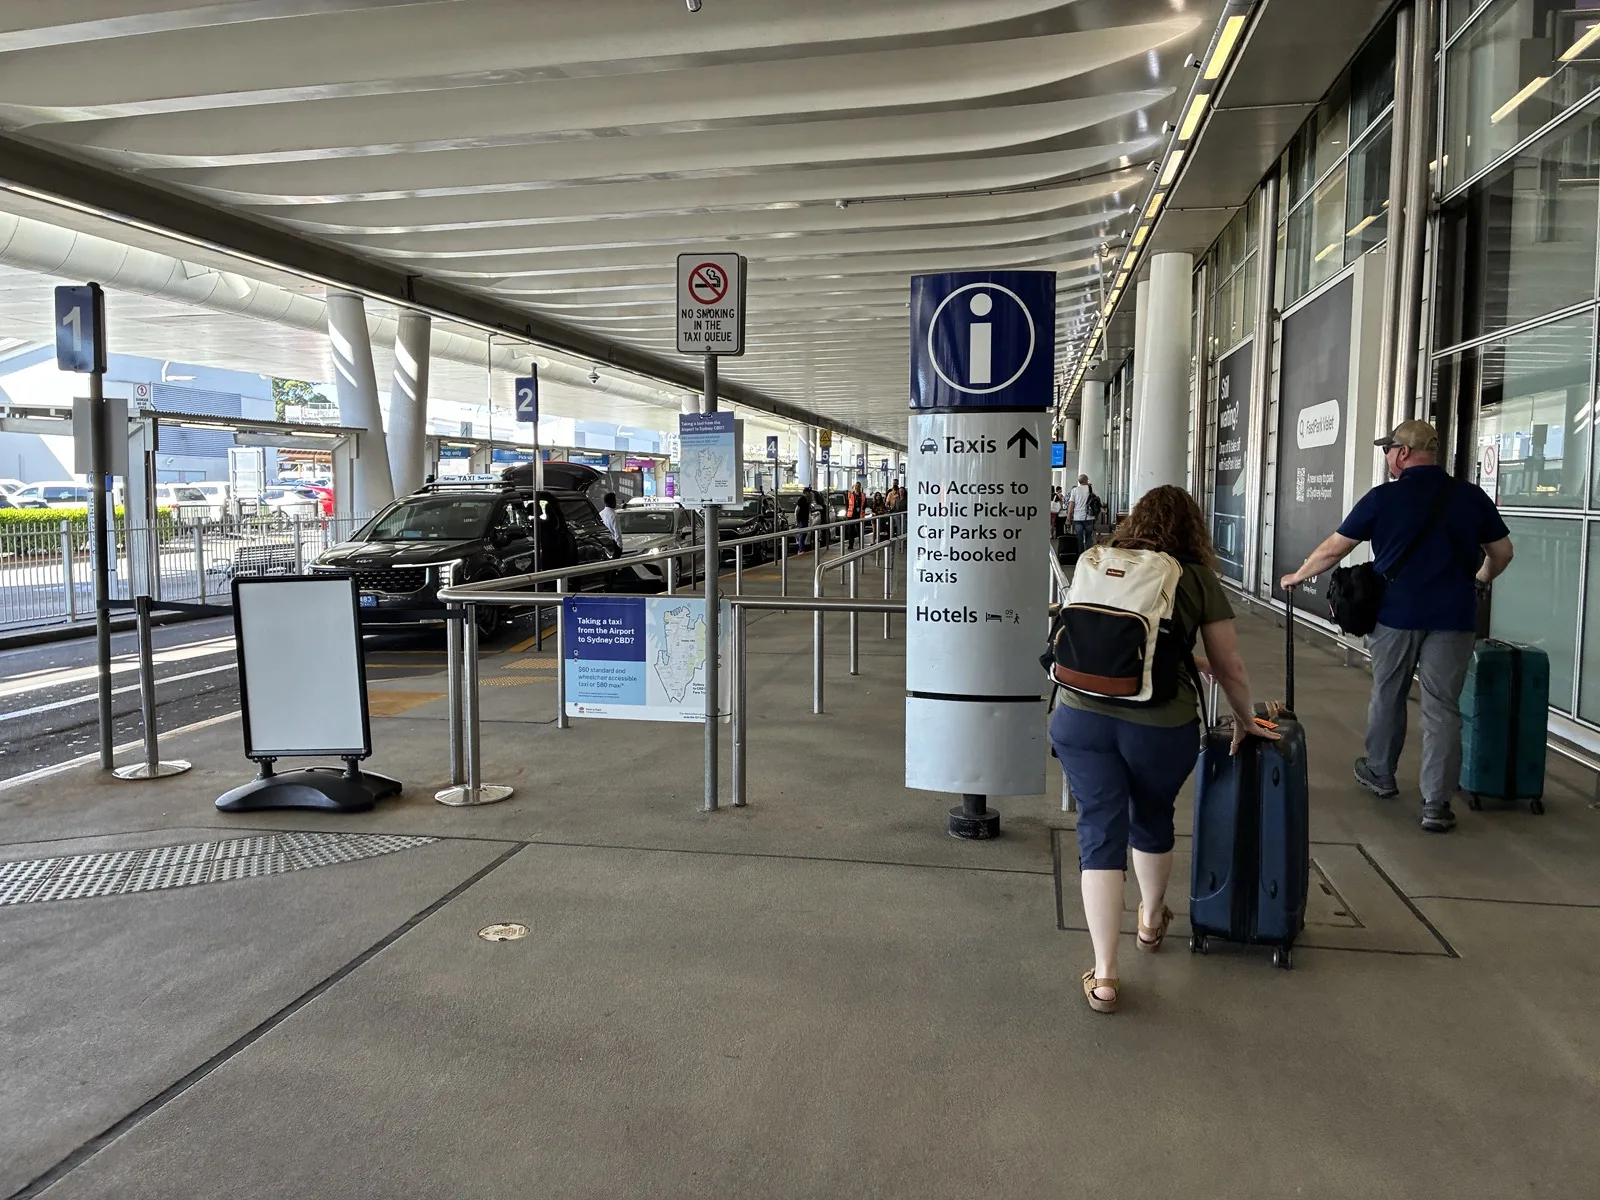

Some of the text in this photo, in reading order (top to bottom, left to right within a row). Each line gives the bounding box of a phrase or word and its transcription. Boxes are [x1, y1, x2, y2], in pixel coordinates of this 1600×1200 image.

[681, 308, 735, 319] NO SMOKING
[62, 306, 83, 352] 1
[693, 320, 721, 330] IN THE
[683, 331, 732, 342] TAXI QUEUE
[518, 388, 533, 412] 2
[767, 440, 776, 454] 4
[942, 434, 997, 454] Taxis
[822, 450, 829, 460] 5
[857, 457, 863, 466] 6
[882, 461, 887, 470] 7
[900, 464, 905, 472] 8
[918, 480, 1029, 495] No Access to
[918, 502, 1038, 520] Public Pick-up
[917, 524, 1022, 539] Car Parks or
[917, 546, 1016, 561] Pre-booked
[917, 568, 958, 583] Taxis
[916, 606, 978, 623] Hotels
[577, 617, 601, 626] Taking
[578, 626, 595, 634] from
[609, 627, 635, 636] Airport
[586, 635, 613, 645] Sydney
[614, 636, 635, 644] CBD?
